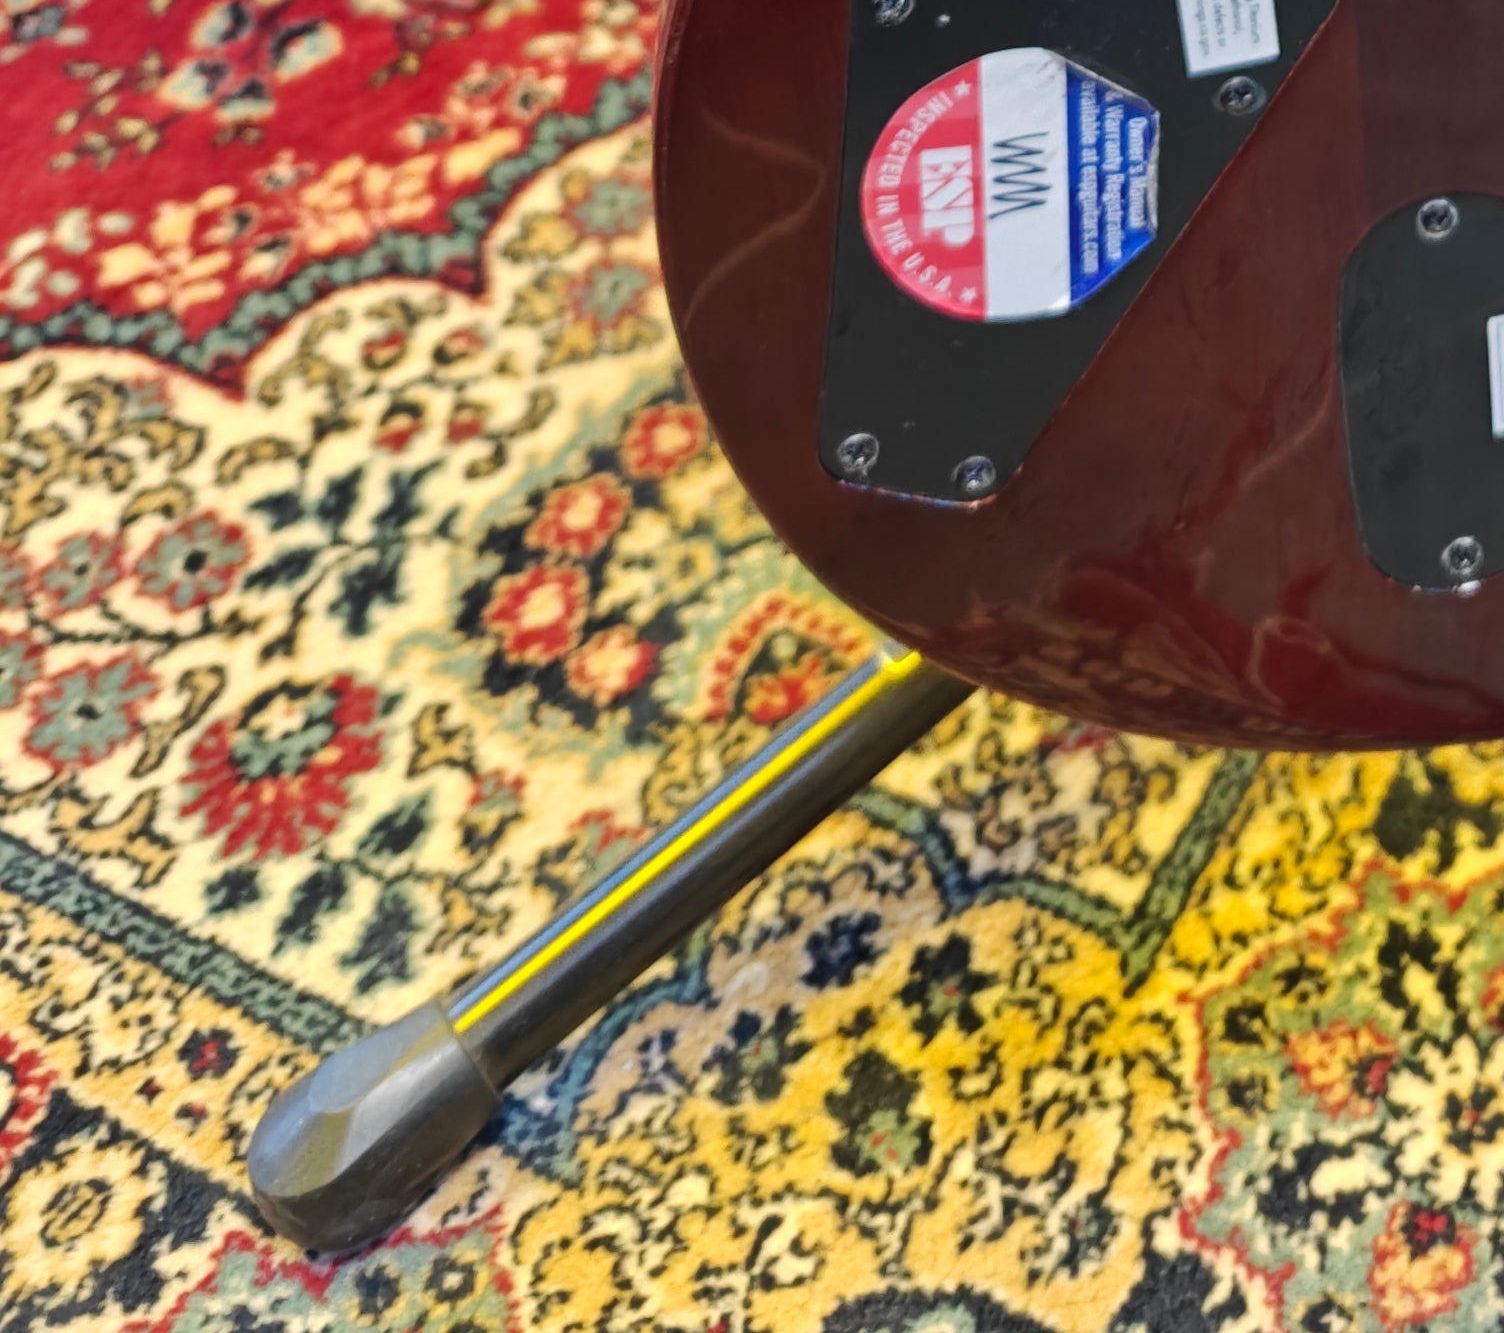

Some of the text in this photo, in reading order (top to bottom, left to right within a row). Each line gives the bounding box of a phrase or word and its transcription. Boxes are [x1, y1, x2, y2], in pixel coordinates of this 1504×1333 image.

[1077, 80, 1100, 274] available at espguitars.com
[1103, 104, 1125, 171] Warranty
[1127, 116, 1148, 229] Owner's Manual
[874, 91, 954, 299] INSPECTED IN THE U.S.A.
[917, 144, 975, 247] ESP
[1103, 174, 1125, 259] Registration
